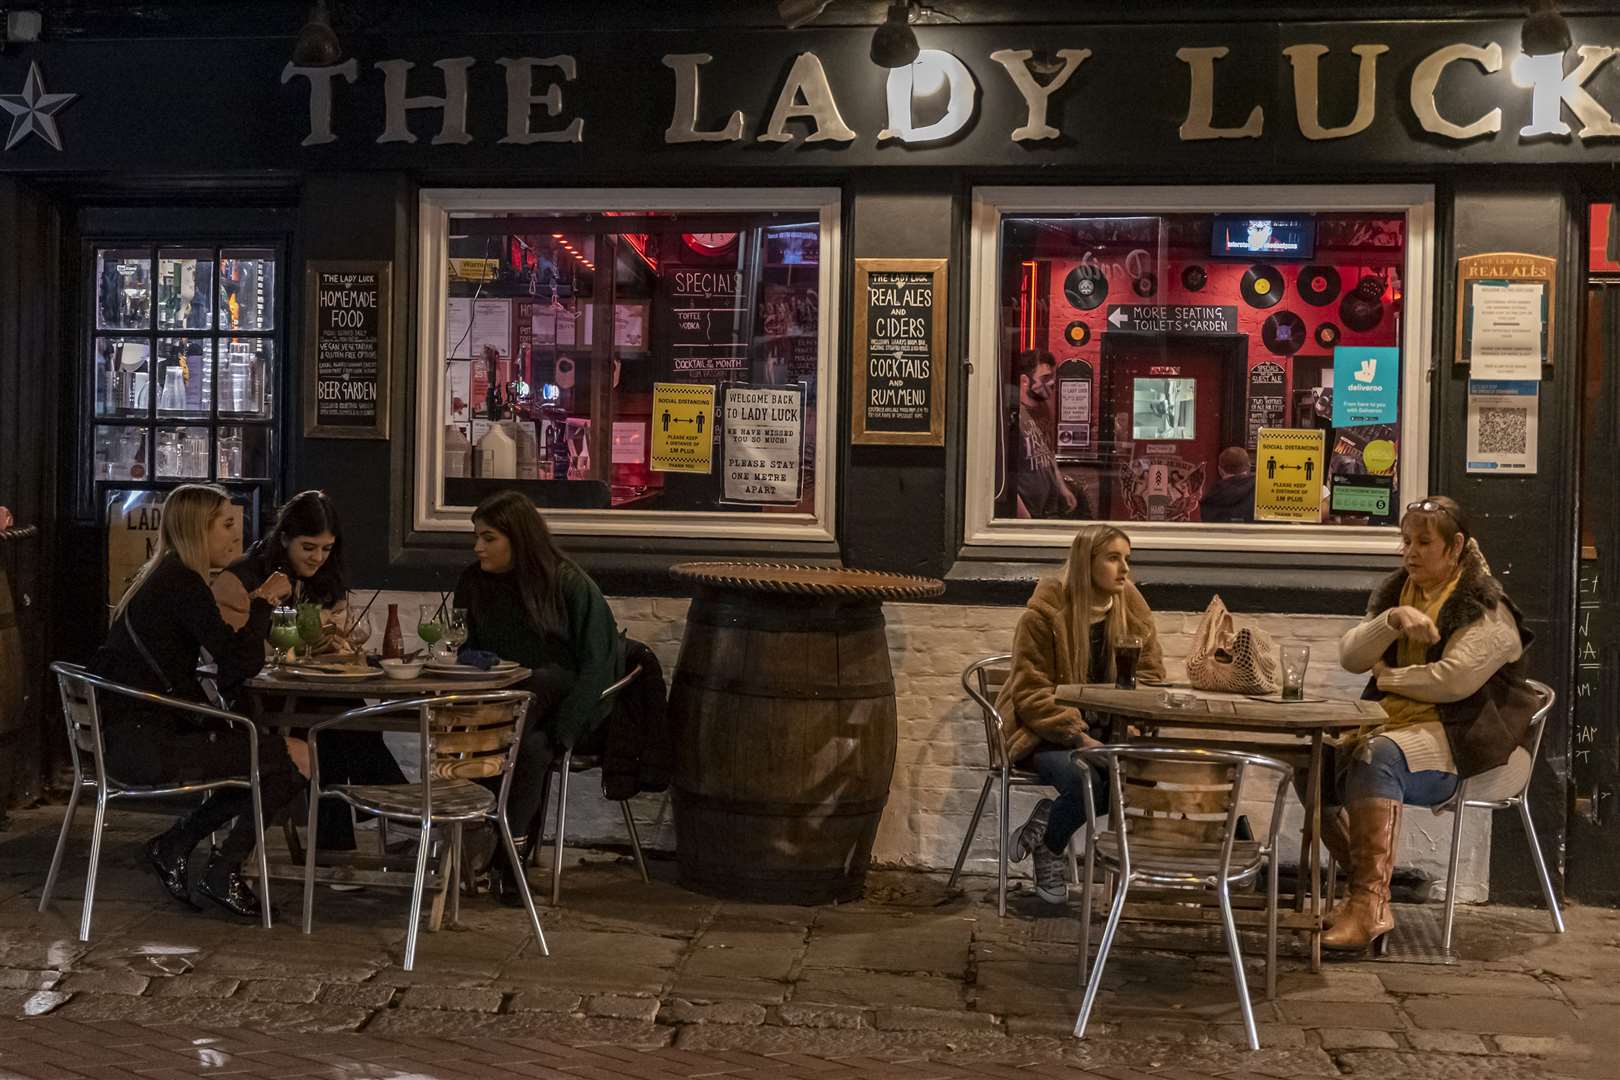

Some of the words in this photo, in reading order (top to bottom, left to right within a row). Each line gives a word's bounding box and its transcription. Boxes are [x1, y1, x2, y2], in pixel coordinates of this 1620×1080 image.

[281, 54, 584, 146] THE
[662, 47, 1092, 144] LADY
[1178, 42, 1620, 142] LUCK
[1469, 264, 1509, 277] REAL
[1512, 263, 1546, 277] ALES
[322, 274, 339, 283] THE
[340, 274, 357, 283] LADY
[358, 274, 375, 283] LUCK
[872, 273, 888, 283] THE
[890, 273, 909, 283] LADY
[910, 274, 928, 283] LUCK
[320, 290, 377, 308] HOMEMADE
[871, 288, 900, 307] REAL
[902, 288, 932, 308] ALES
[331, 309, 364, 328] FOOD
[890, 308, 907, 316] AND
[1133, 306, 1167, 320] MORE
[876, 317, 925, 339] CIDERS
[675, 359, 706, 369] COCKTAIL
[715, 359, 742, 368] MONTH
[870, 358, 930, 379] COCKTAILS
[318, 381, 342, 400] BEER
[341, 381, 377, 401] GARDEN
[871, 388, 896, 406] RUM
[897, 388, 926, 406] MENU
[729, 393, 768, 404] WELCOME
[771, 395, 794, 405] BACK
[727, 408, 738, 419] TO
[741, 407, 768, 421] LADY
[771, 408, 799, 422] LUCK
[741, 428, 761, 436] HAVE
[764, 429, 794, 437] MISSED
[728, 459, 766, 468] PLEASE
[770, 460, 795, 469] STAY
[731, 472, 750, 480] ONE
[754, 473, 787, 482] METRE
[745, 485, 776, 495] APART
[127, 508, 161, 531] LAD
